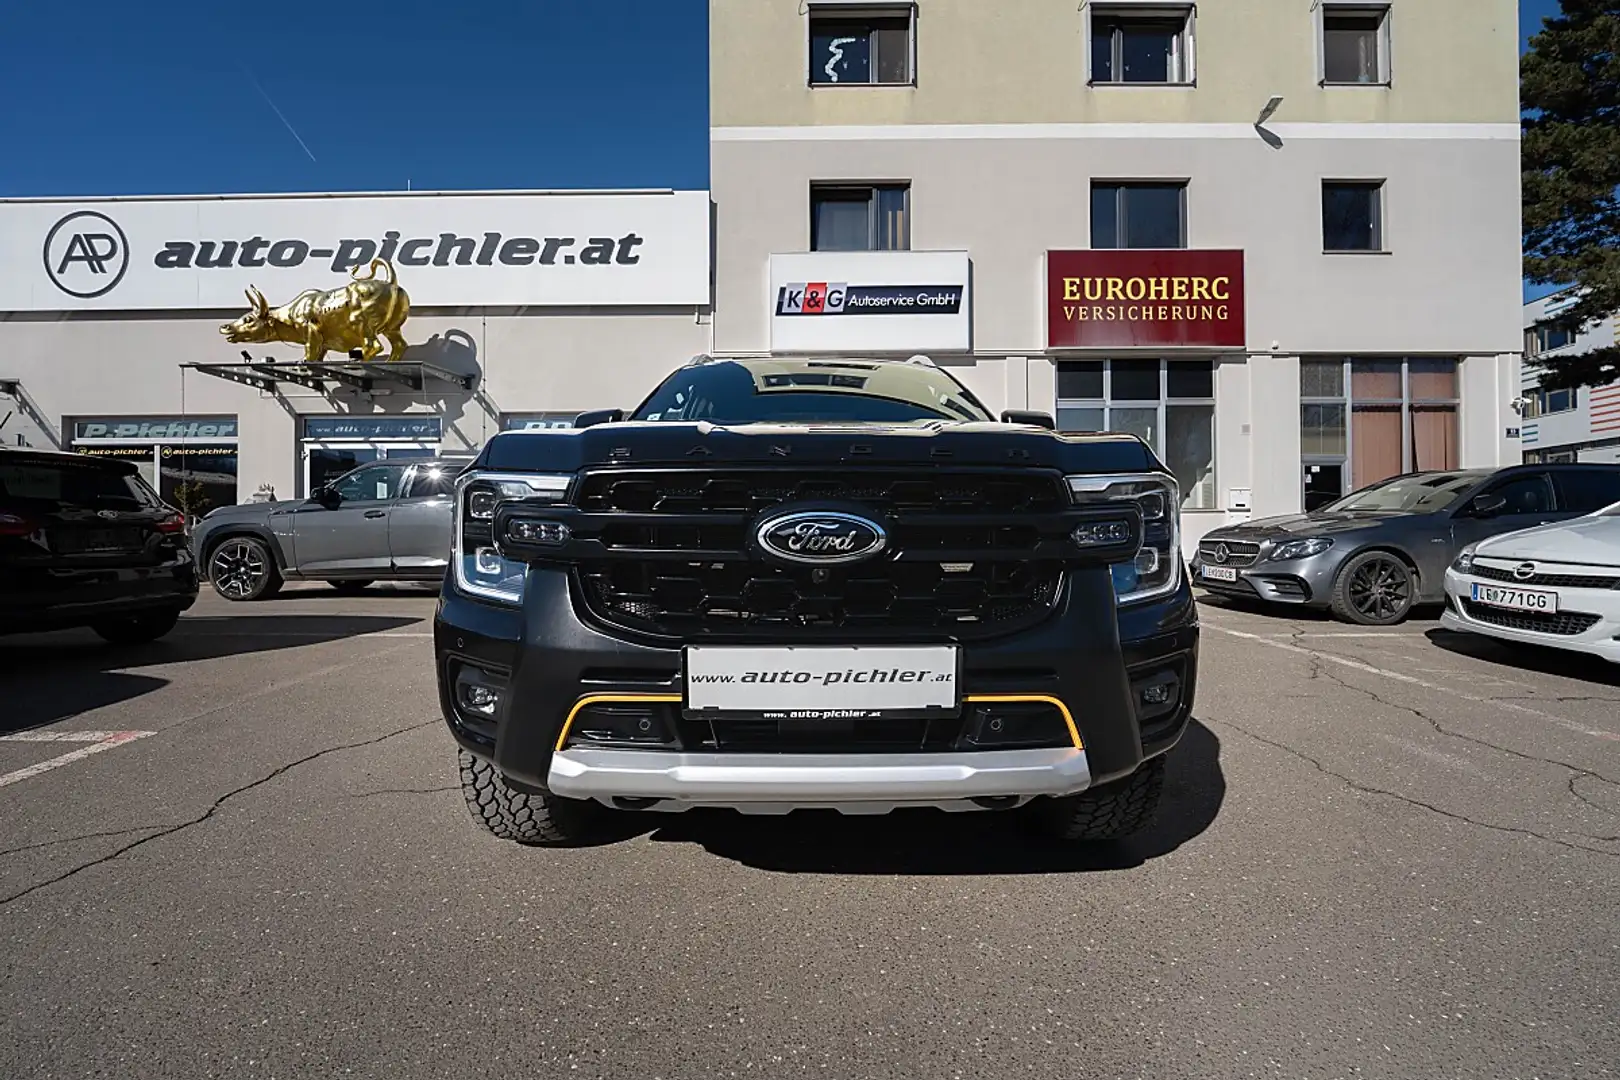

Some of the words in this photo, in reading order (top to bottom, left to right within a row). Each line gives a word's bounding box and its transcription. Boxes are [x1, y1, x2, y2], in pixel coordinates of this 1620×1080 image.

[57, 233, 118, 274] AP
[154, 231, 643, 272] auto-pichler.at
[787, 289, 843, 309] K&G
[848, 294, 914, 306] Autoservice
[916, 293, 956, 306] GmbH
[1063, 277, 1229, 300] EUROHERC
[1063, 305, 1229, 321] VERSICHERUNG
[788, 522, 857, 550] Ford
[1480, 587, 1491, 601] LE
[1500, 589, 1546, 608] 771CG
